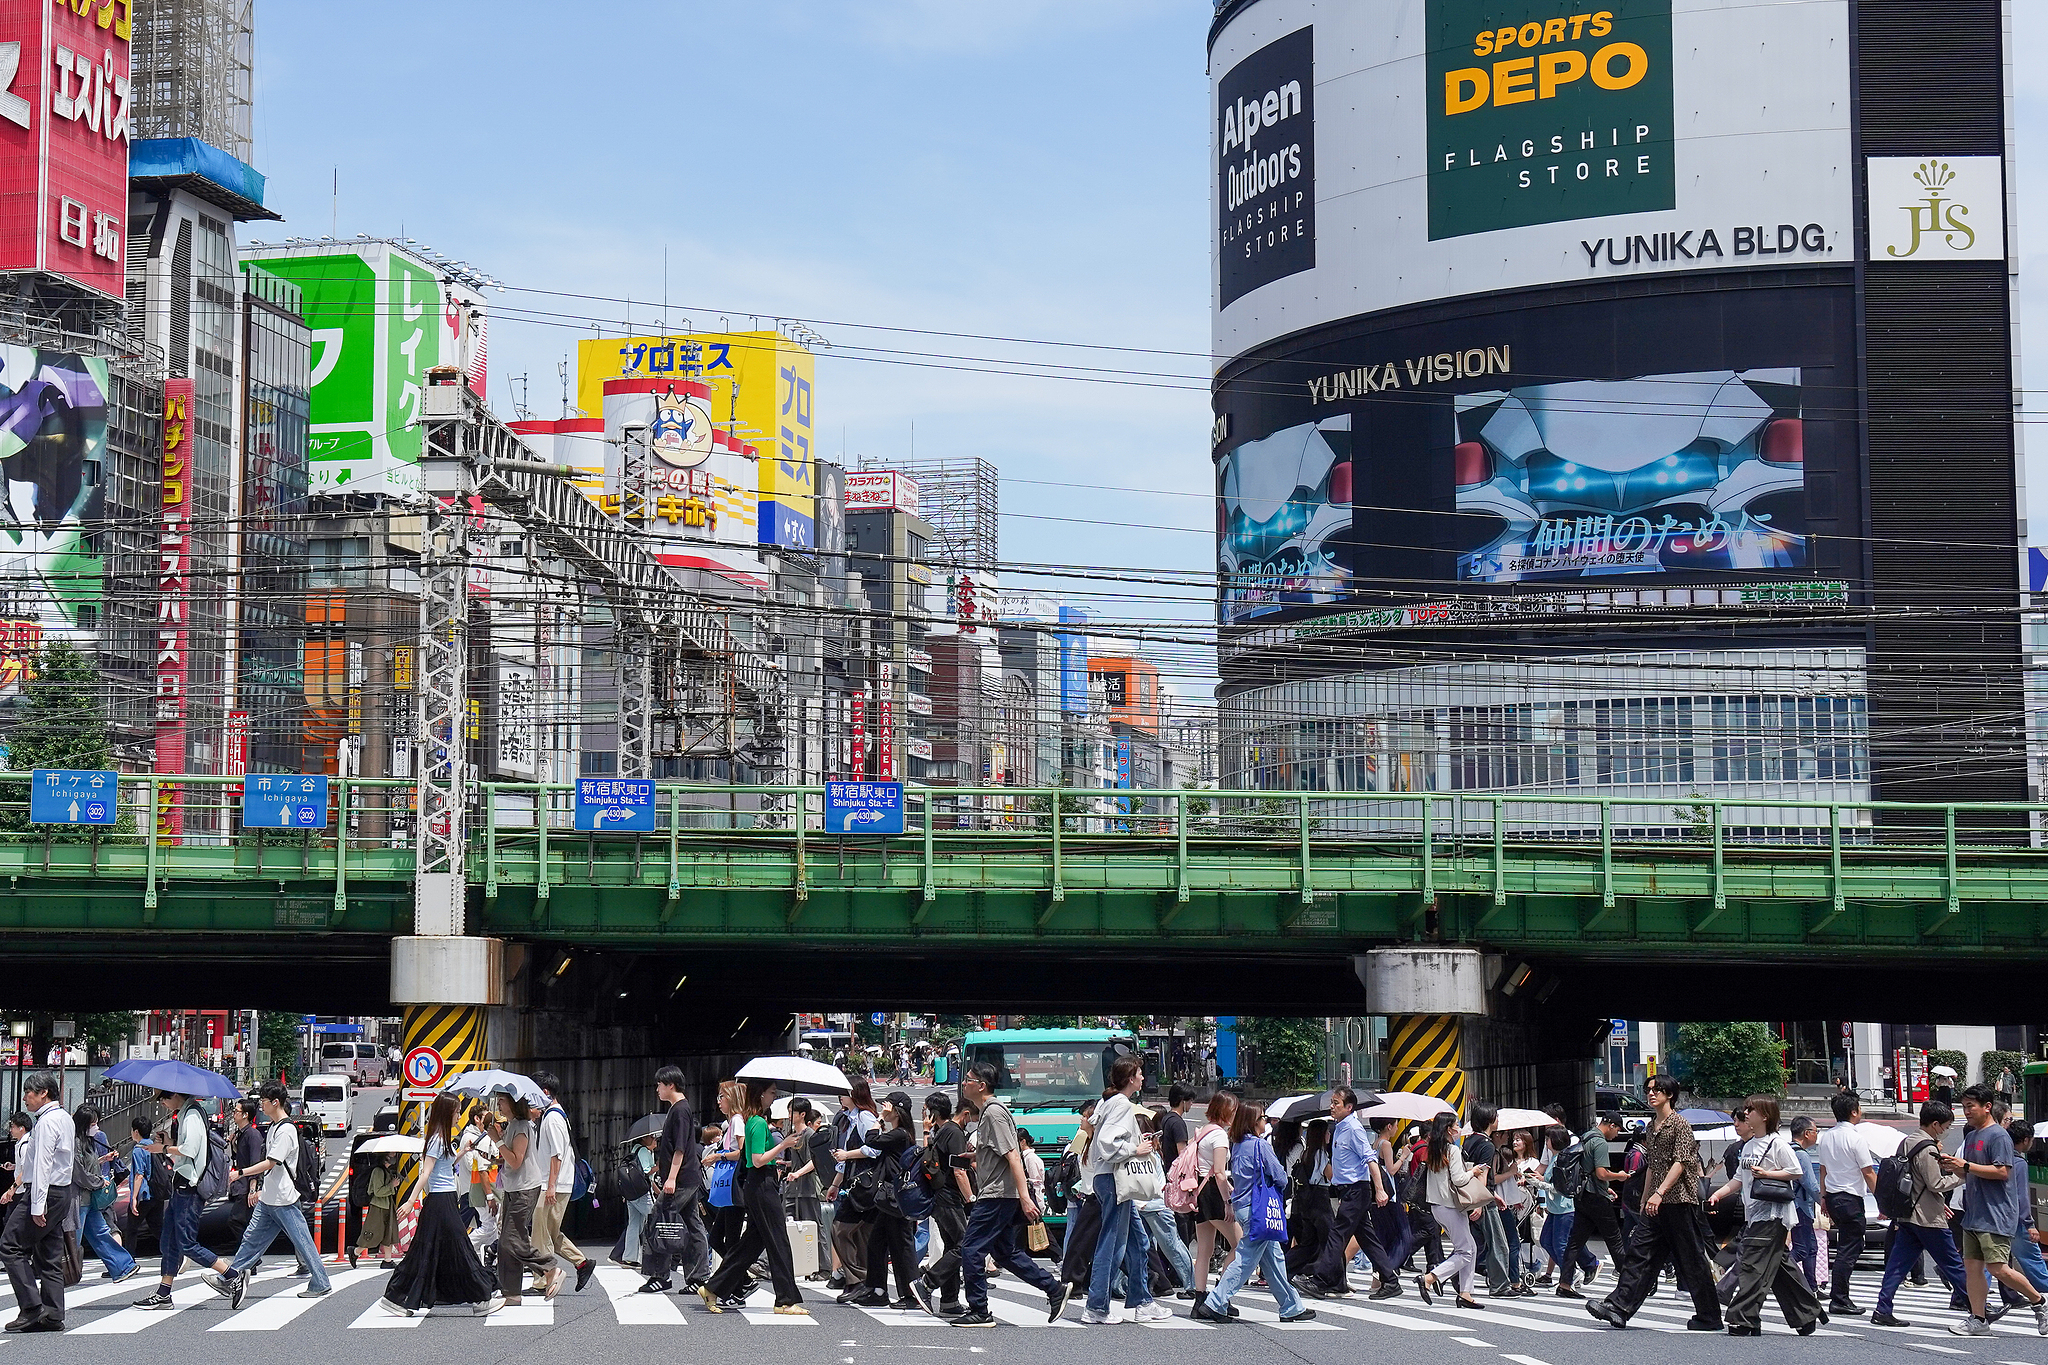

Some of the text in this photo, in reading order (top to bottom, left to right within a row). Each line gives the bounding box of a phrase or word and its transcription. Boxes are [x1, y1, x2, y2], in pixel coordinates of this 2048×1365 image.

[1473, 10, 1614, 57] SPORTS
[1445, 42, 1648, 116] DEPO
[1222, 78, 1302, 157] Alpen
[1445, 125, 1650, 171] FLAGSHIP
[1227, 141, 1302, 212] Outdoors
[1518, 155, 1651, 188] STORE
[60, 194, 119, 262] 日拓
[1223, 190, 1303, 246] FLAGSHIP
[1245, 219, 1305, 259] STORE
[1581, 223, 1834, 268] YUNIKA BLDG.
[619, 342, 734, 374] プロミス
[1307, 345, 1511, 406] YUNIKA VISION
[163, 394, 186, 503] パチンコ
[848, 476, 884, 487] カラオケ
[1532, 511, 1774, 559] 仲間のために
[158, 513, 182, 665] エスパス
[51, 789, 97, 800] Ichigaya
[263, 793, 308, 804] Ichigaya
[581, 780, 650, 796] 新宿駅東口
[584, 795, 618, 805] Shinjuku
[830, 783, 897, 799] 新宿駅東口
[832, 798, 866, 808] Shinjuku
[89, 807, 102, 816] 302
[301, 811, 313, 820] 302
[1124, 1160, 1154, 1176] TOKYO
